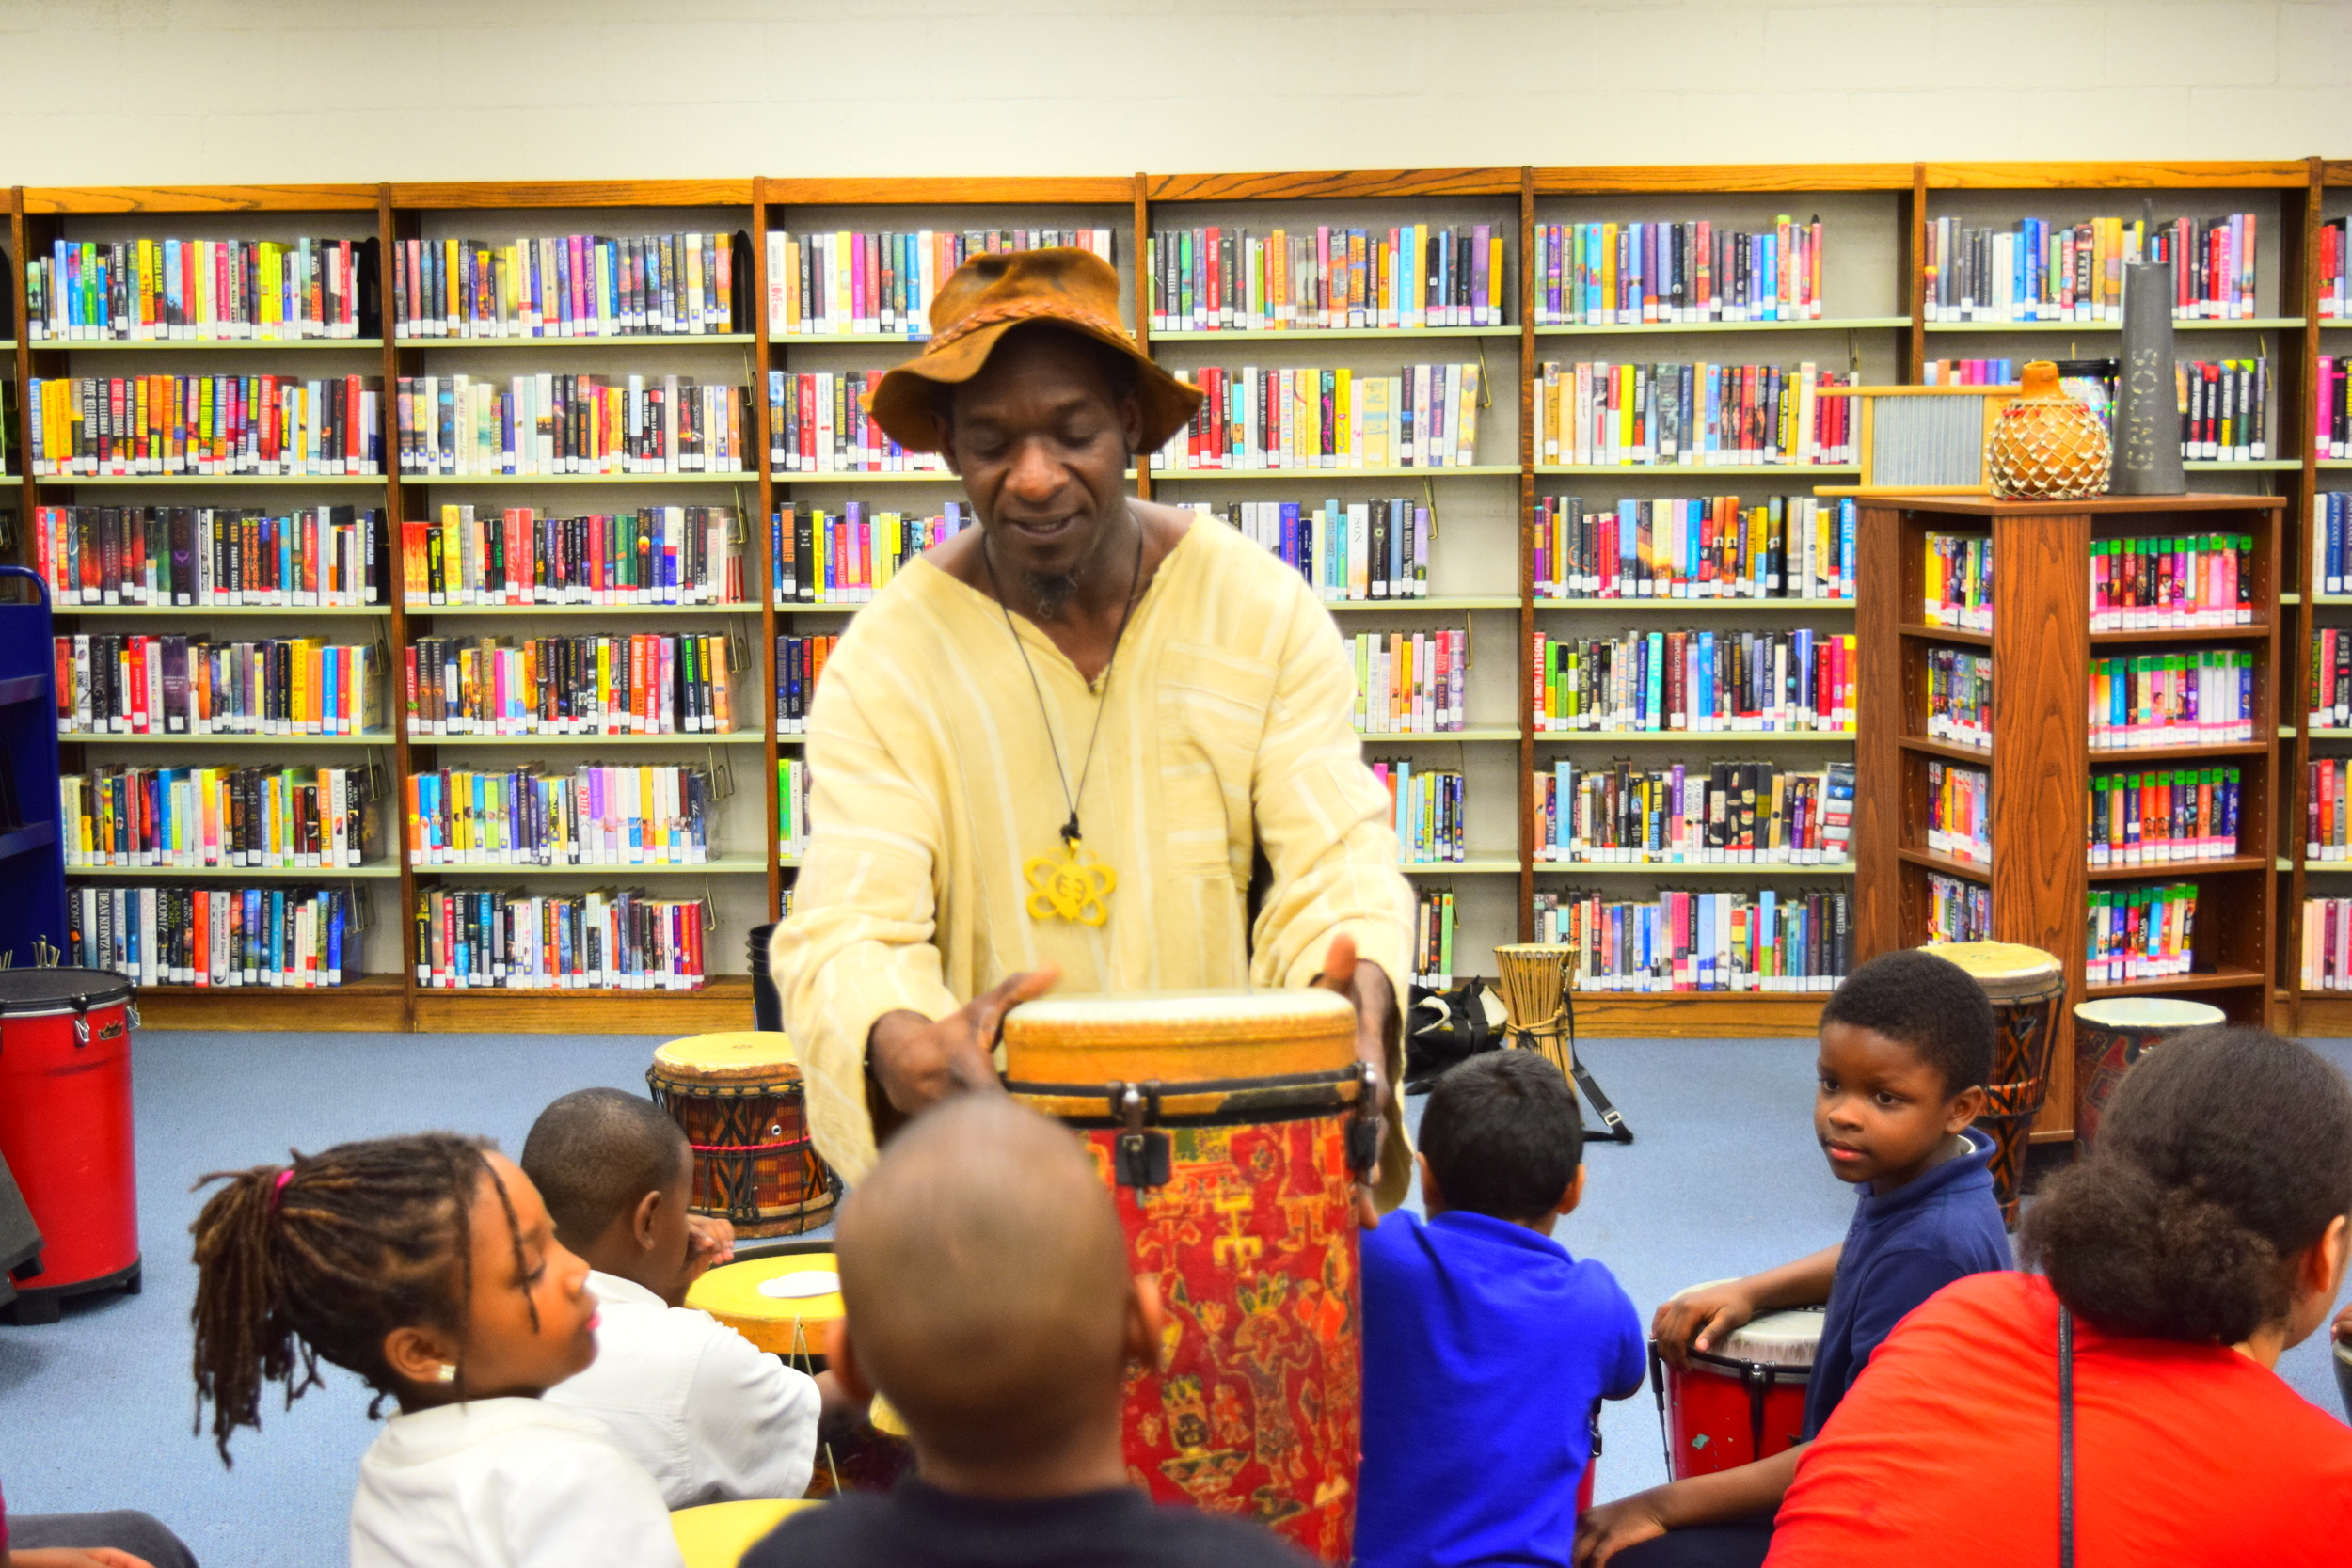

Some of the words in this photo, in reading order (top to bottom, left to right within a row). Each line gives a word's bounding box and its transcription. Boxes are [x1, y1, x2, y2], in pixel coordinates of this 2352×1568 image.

[667, 270, 672, 279] OF
[2064, 248, 2073, 277] VIPER
[771, 283, 782, 302] LOVE
[31, 386, 40, 408] LITTLE
[85, 380, 95, 396] FAYE
[113, 384, 123, 399] FAYE
[836, 391, 845, 403] VAN
[32, 411, 40, 443] CENTURY
[85, 399, 96, 438] KELLERMAN
[100, 399, 108, 434] KELLERMAN
[113, 401, 123, 436] KELLERMAN
[836, 404, 845, 435] LUSTBADER
[783, 510, 792, 536] NORMAN
[1404, 503, 1412, 528] BARBARA
[1843, 503, 1851, 540] MOSLEY
[784, 538, 793, 562] MAILER
[1404, 531, 1412, 559] MICHAELS
[1534, 638, 1544, 674] MOSLEY
[634, 658, 643, 688] Lescroart
[1452, 670, 1460, 691] TEXAS
[1534, 680, 1543, 698] LONG
[334, 782, 344, 815] KOONTZ
[579, 786, 590, 816] DEXTER
[1653, 781, 1662, 793] THIN
[321, 790, 330, 818] KOONTZ
[1653, 795, 1662, 811] WALLS
[1649, 812, 1659, 824] KRIS
[1649, 826, 1659, 850] NELSCOTT
[70, 895, 79, 928] KOONTZ
[98, 893, 108, 915] DEAN
[158, 895, 168, 932] KOONTZ
[1836, 897, 1845, 934] UNWANTED
[99, 917, 109, 949] KOONTZ
